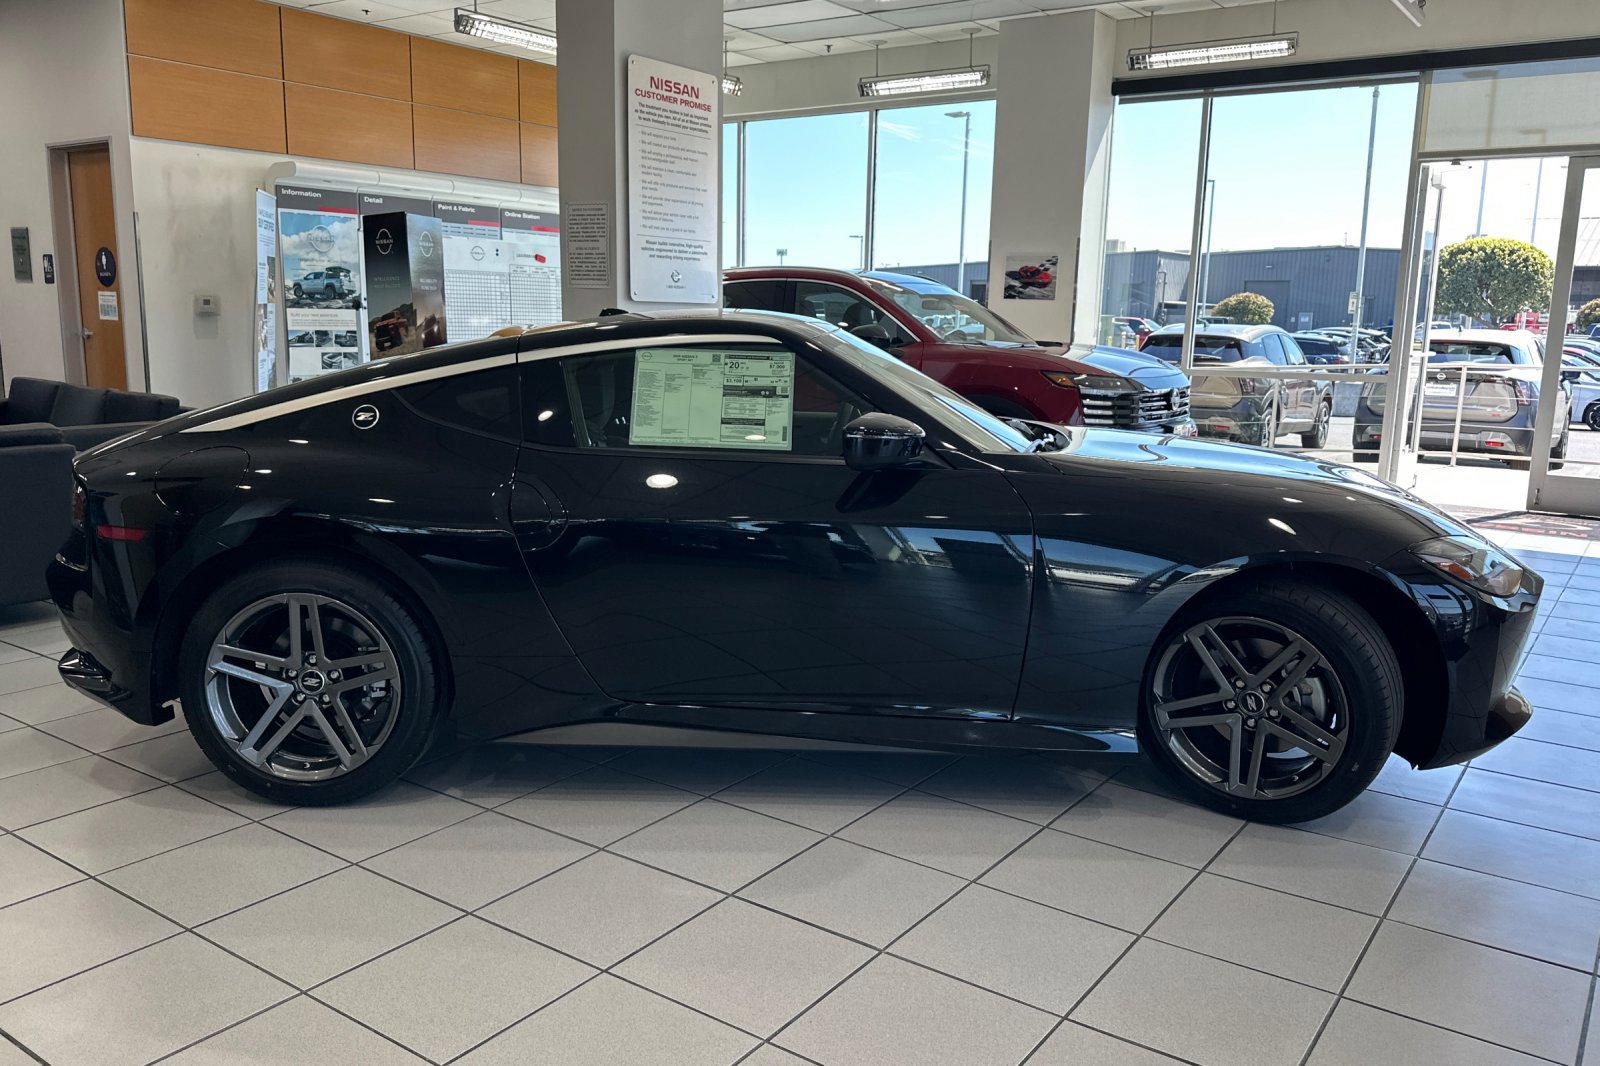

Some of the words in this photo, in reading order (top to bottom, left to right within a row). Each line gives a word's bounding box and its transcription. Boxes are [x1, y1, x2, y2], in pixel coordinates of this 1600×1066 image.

[650, 76, 700, 99] NISSAN
[635, 88, 678, 104] CUSTOMER
[680, 98, 712, 112] PROMISE
[282, 188, 322, 198] Information
